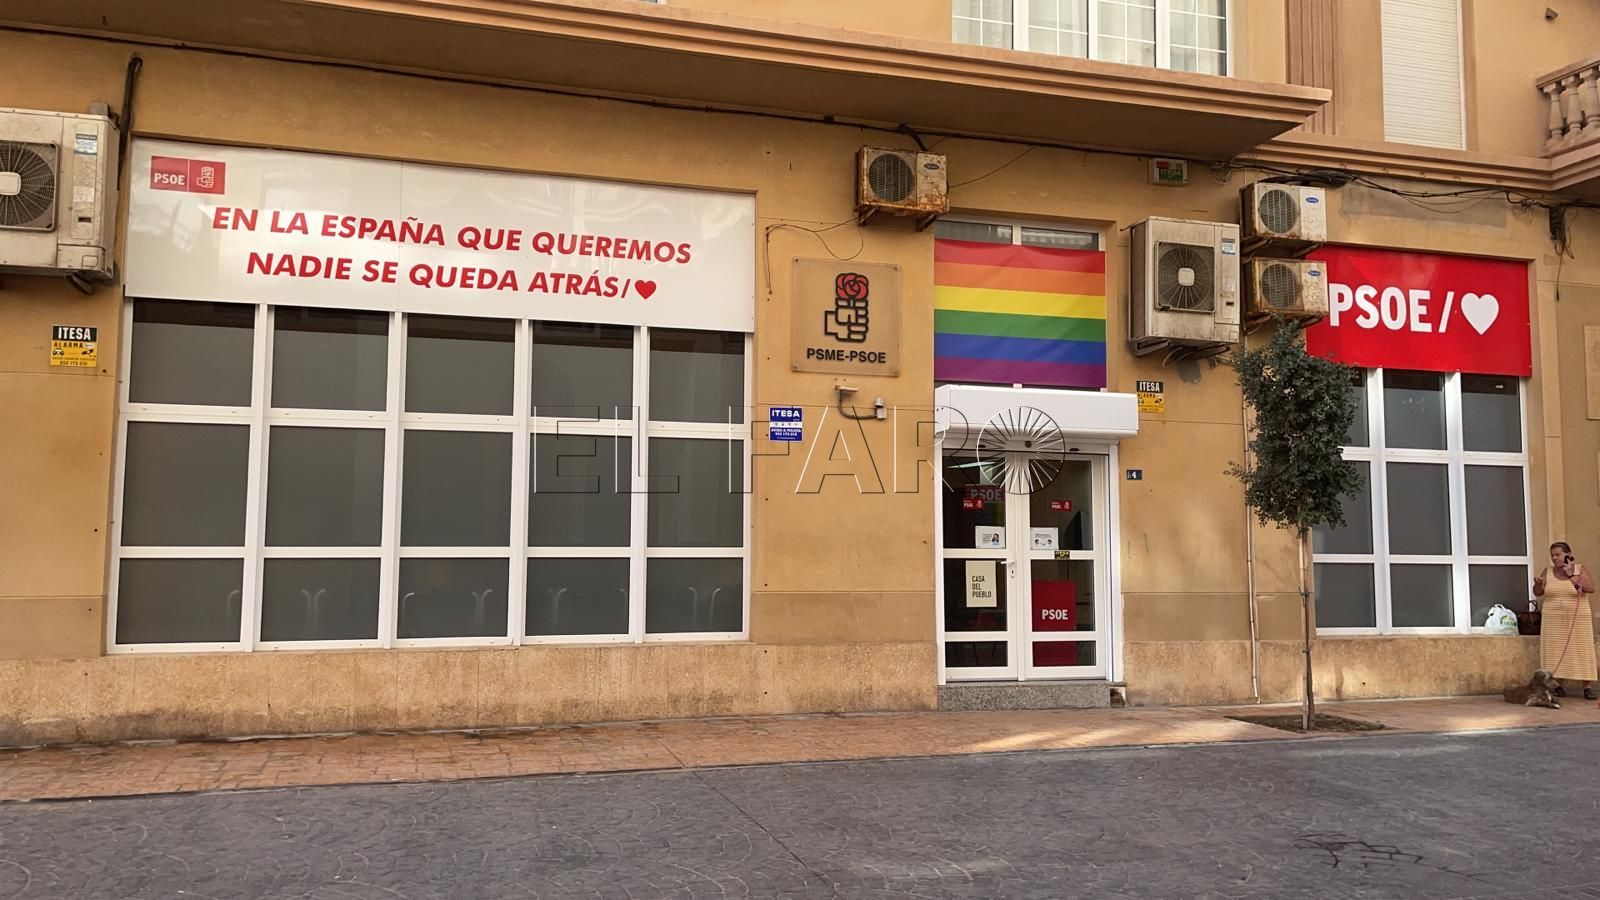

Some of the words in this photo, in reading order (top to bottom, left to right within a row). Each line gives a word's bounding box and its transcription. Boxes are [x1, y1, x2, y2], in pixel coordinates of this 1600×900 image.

[153, 172, 186, 186] PSOE
[212, 206, 259, 232] EN
[270, 210, 309, 235] LA
[321, 214, 446, 246] ESPAÑA
[457, 226, 522, 251] QUE
[532, 231, 692, 264] QUEREMOS
[246, 252, 353, 280] NADIE
[361, 259, 399, 283] SE
[409, 263, 519, 292] QUEDA
[58, 327, 91, 340] ITESA
[53, 341, 84, 349] ALARMA
[806, 347, 887, 364] PSME-PSOE
[1139, 381, 1160, 392] ITESA
[771, 409, 800, 417] ITESA
[970, 488, 1003, 501] PSOE
[971, 582, 982, 590] DEL
[972, 590, 992, 598] PUEBLO
[1041, 608, 1069, 621] PSOE
